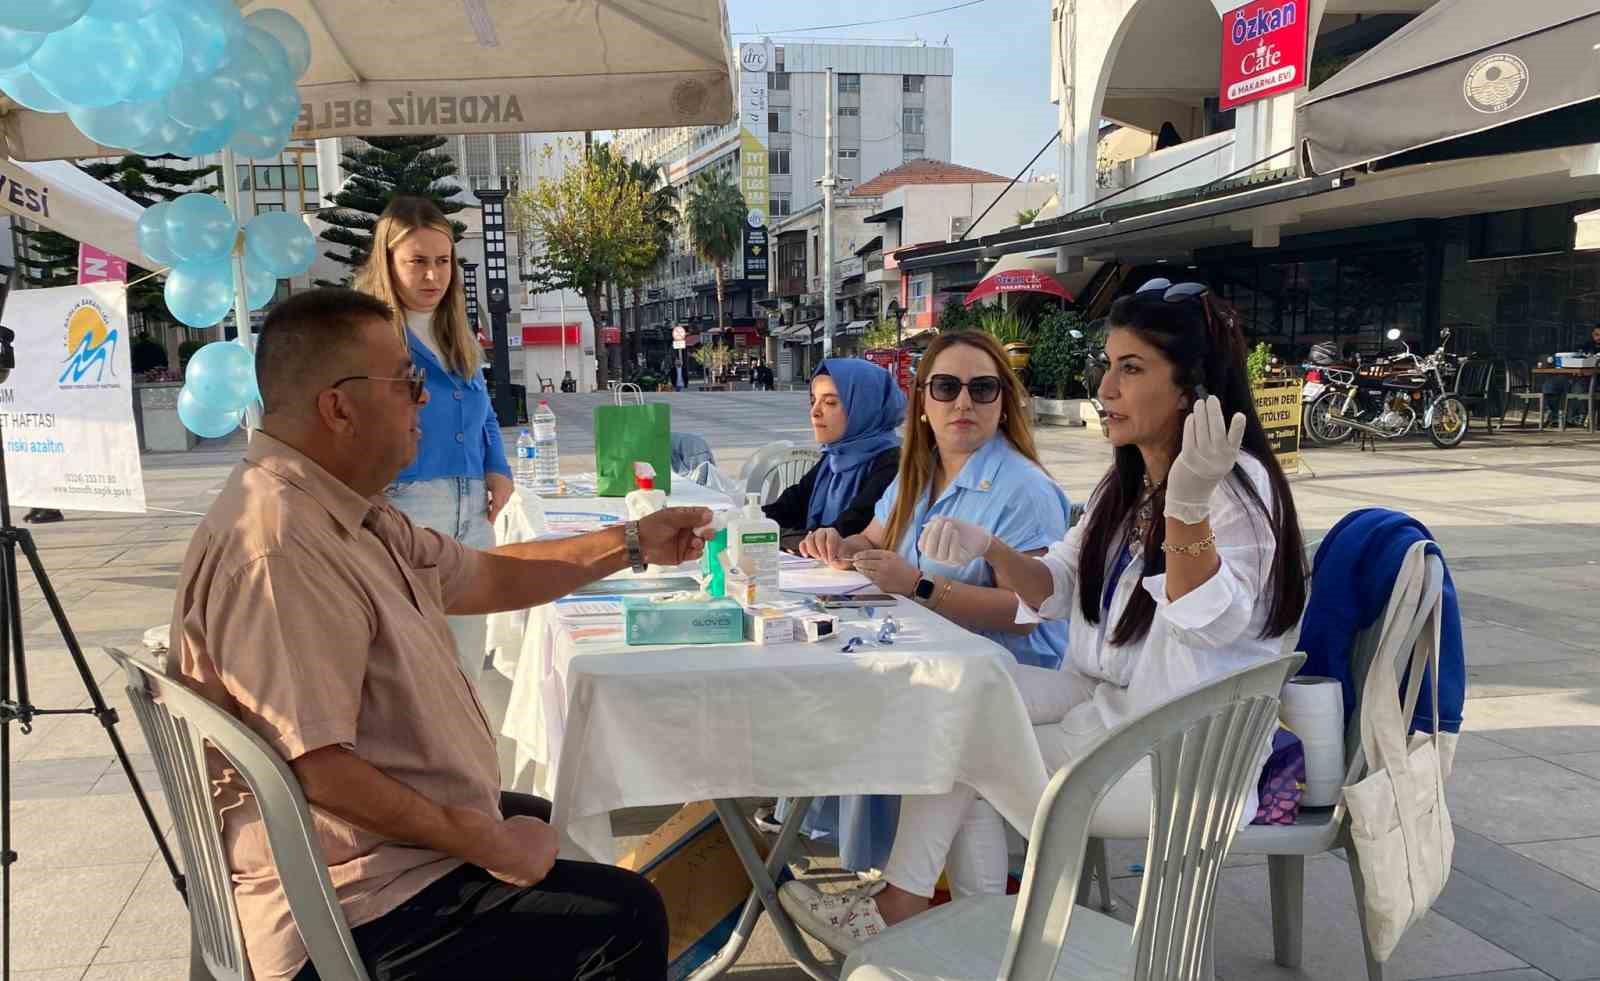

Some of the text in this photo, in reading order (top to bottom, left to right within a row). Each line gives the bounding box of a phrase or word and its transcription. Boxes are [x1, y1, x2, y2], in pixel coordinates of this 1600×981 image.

[1232, 2, 1296, 45] Özkan
[1241, 43, 1281, 75] Cafe
[1238, 76, 1277, 94] MAKARNA
[12, 413, 55, 428] HAFTASI
[8, 439, 28, 452] riski
[691, 618, 731, 628] GLOVES
